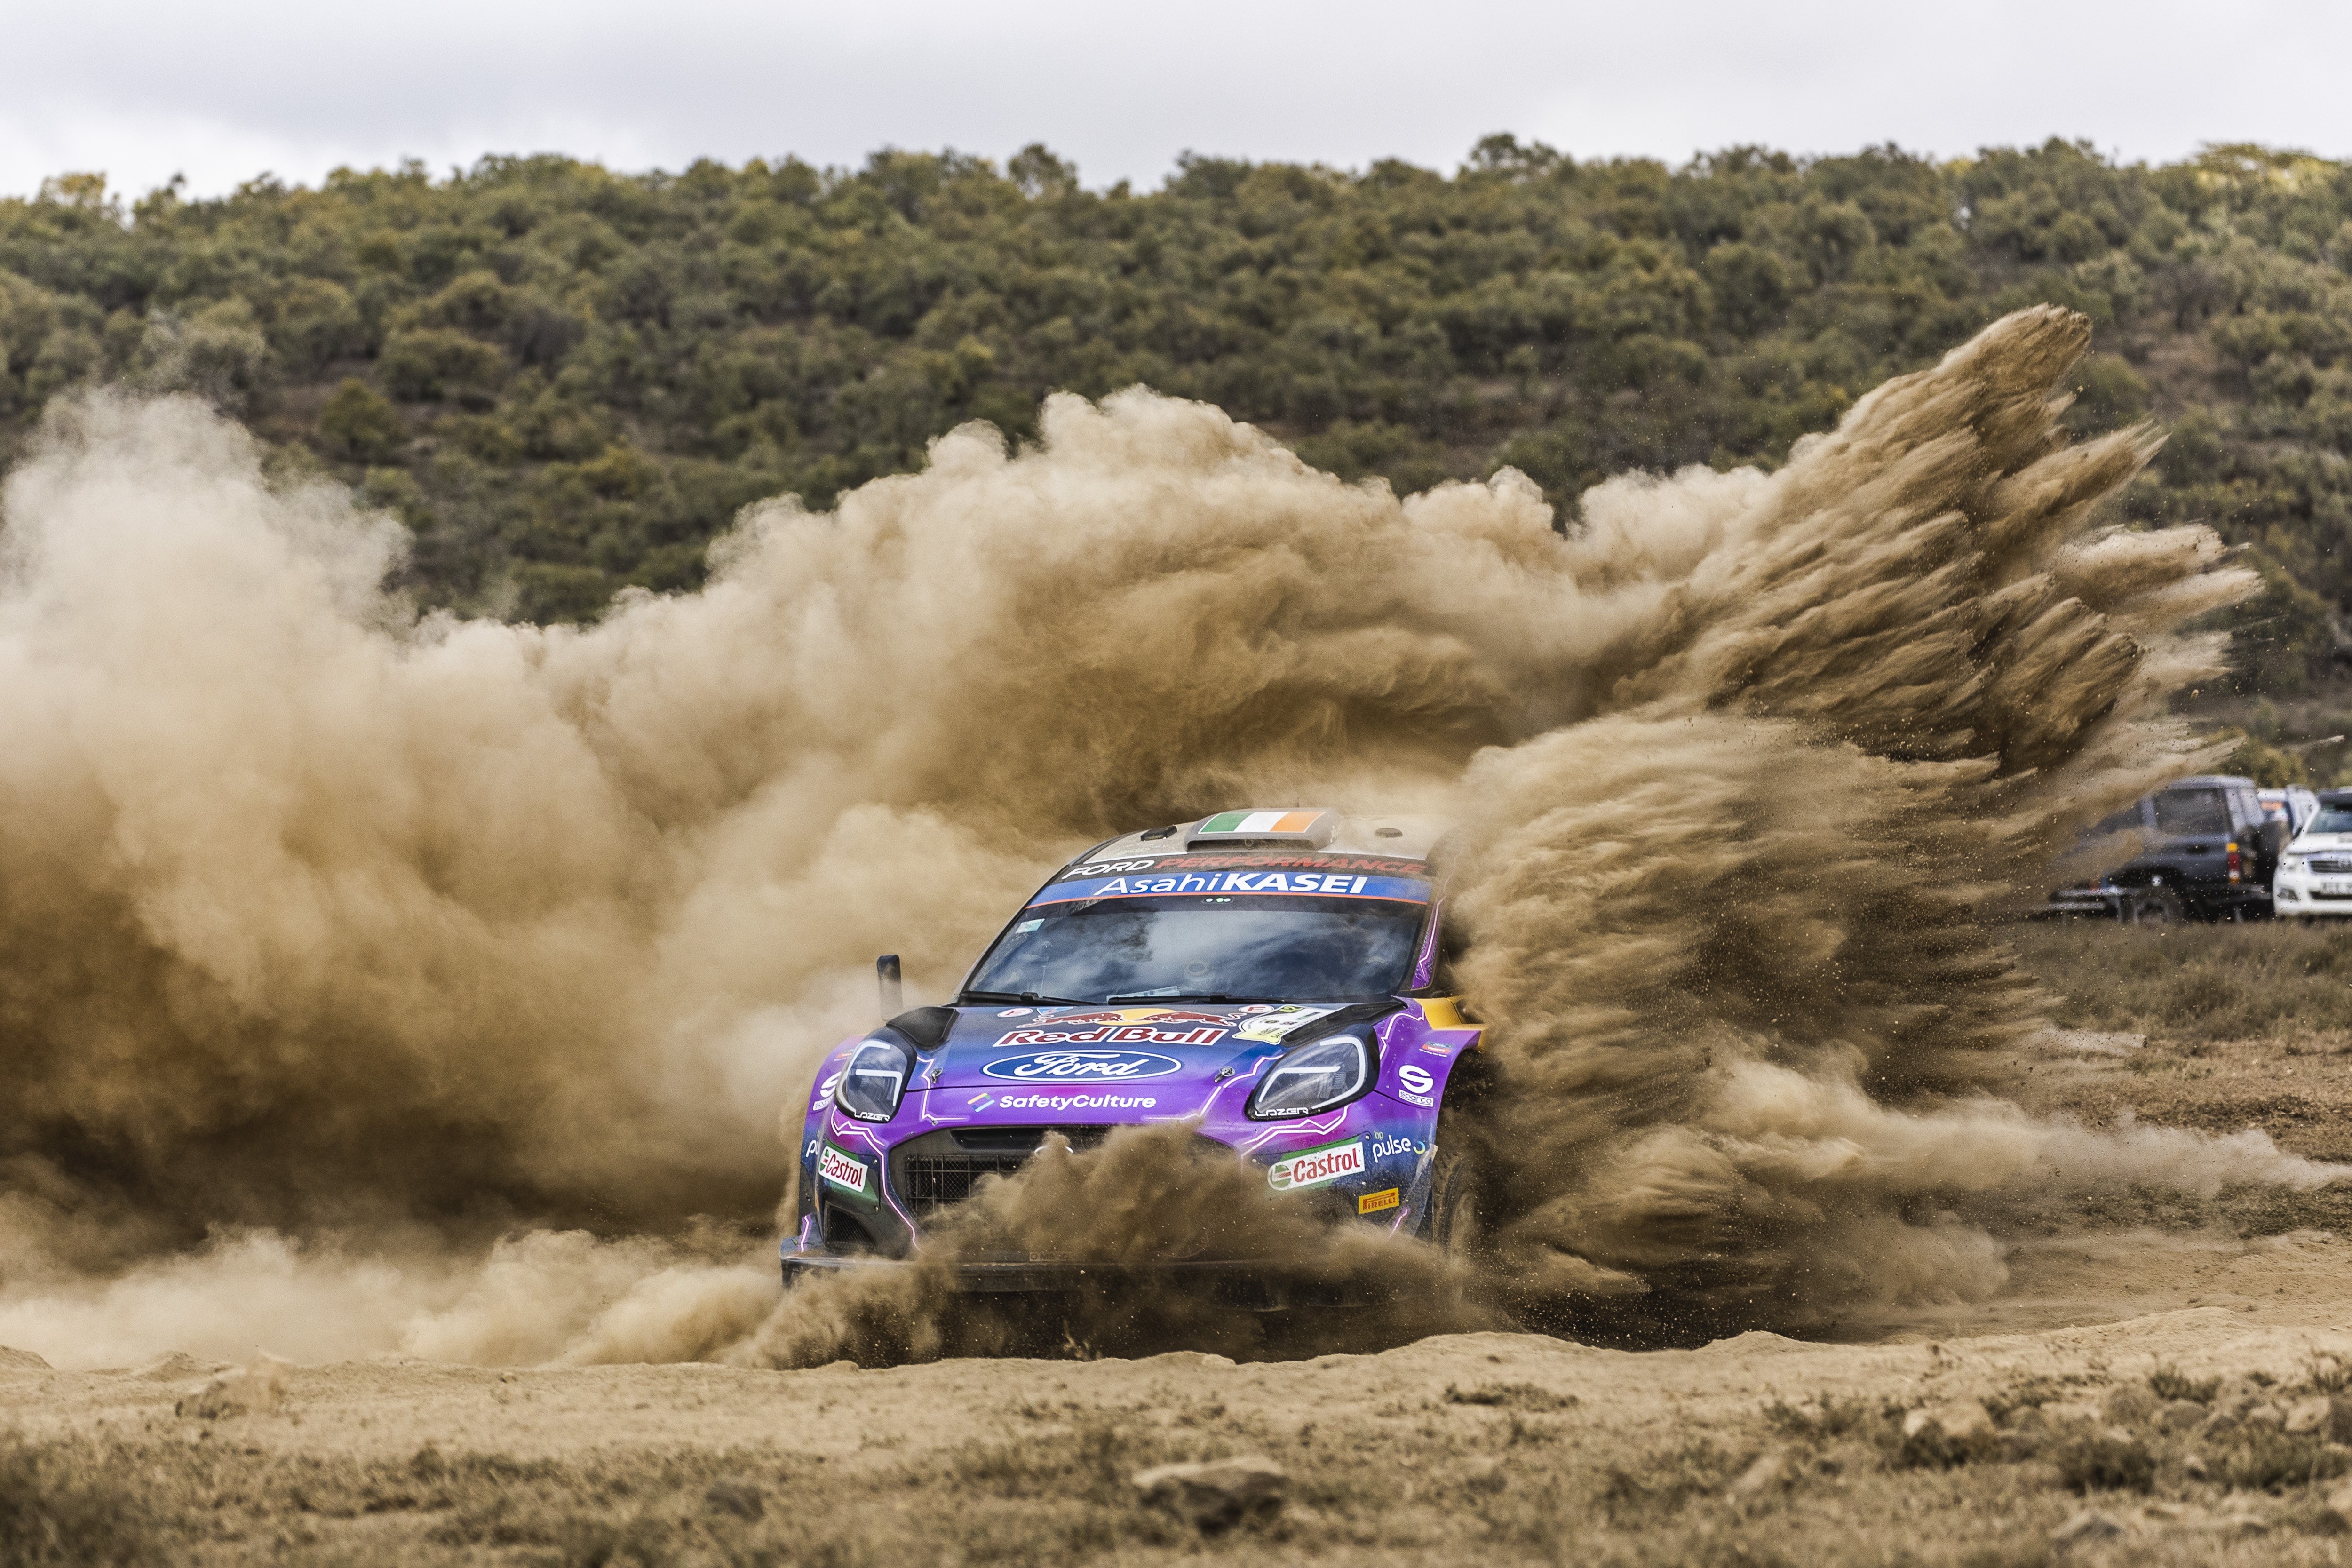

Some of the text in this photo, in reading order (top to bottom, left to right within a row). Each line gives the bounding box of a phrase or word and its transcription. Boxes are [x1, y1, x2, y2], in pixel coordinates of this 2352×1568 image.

[1062, 856, 1428, 879] FORD PERFORMANCE
[995, 1027, 1227, 1046] Red Bull
[1014, 1053, 1150, 1076] Ford
[1000, 1095, 1156, 1110] SafetyCulture
[1400, 1091, 1432, 1104] sparco
[854, 1109, 890, 1122] LAZER
[1255, 1107, 1309, 1117] LAZER
[1374, 1131, 1384, 1140] bp
[1373, 1135, 1411, 1163] pulse
[826, 1154, 863, 1187] Castrol
[1294, 1148, 1360, 1183] Castrol
[1363, 1192, 1396, 1210] PIRELLI
